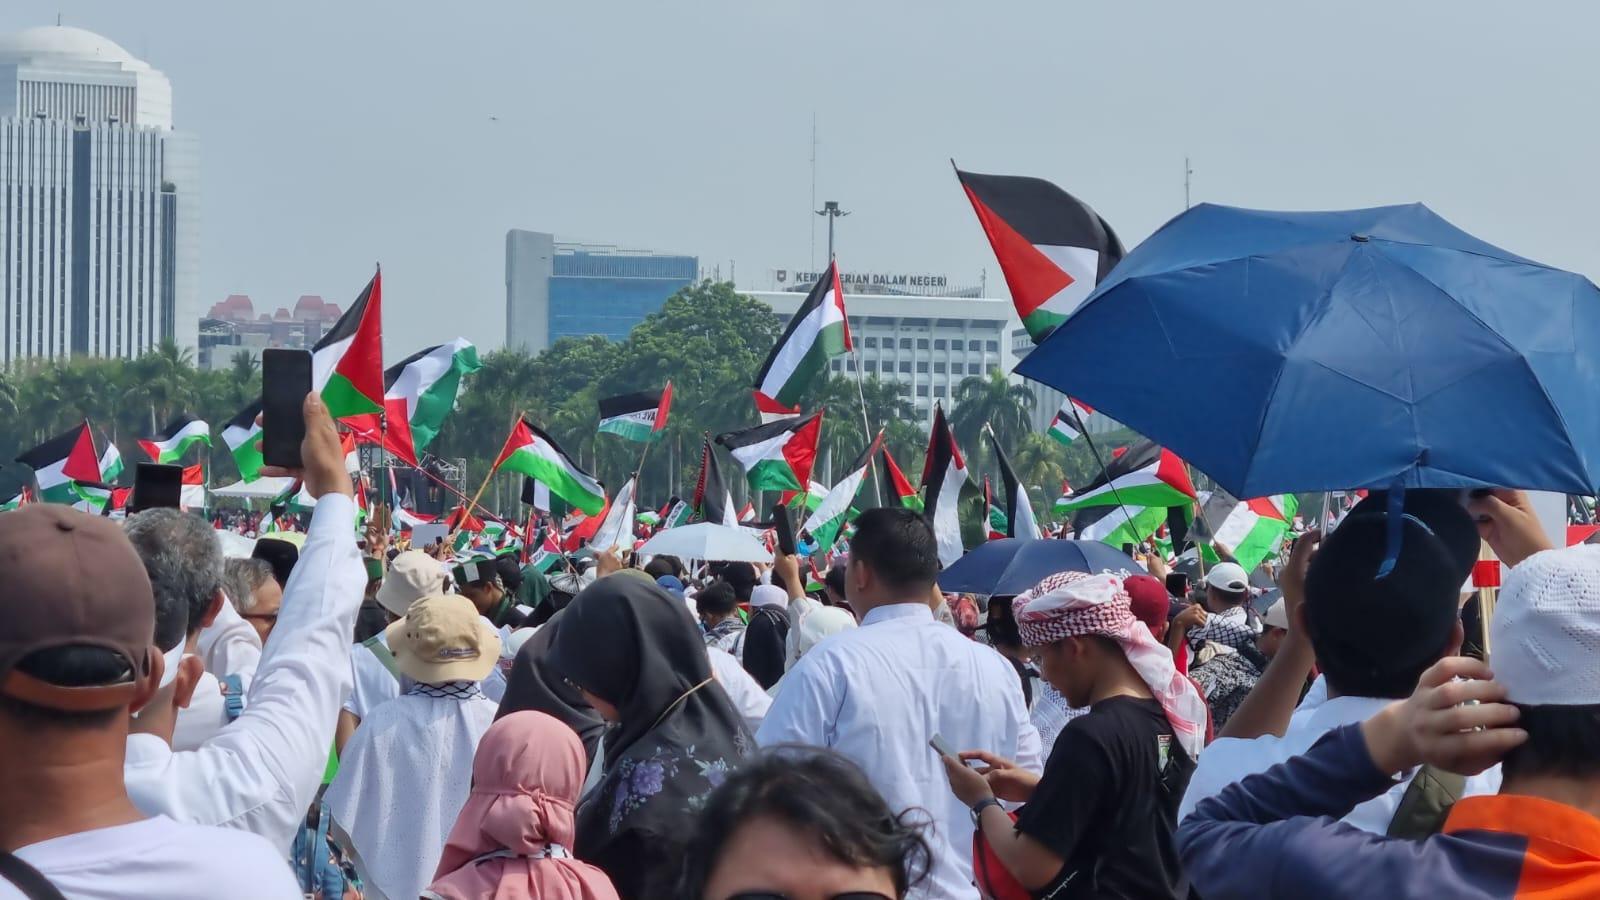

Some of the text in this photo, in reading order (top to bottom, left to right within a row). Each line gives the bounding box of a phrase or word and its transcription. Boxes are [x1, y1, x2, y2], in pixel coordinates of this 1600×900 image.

[796, 272, 947, 286] KEMERIAN DALAM NEGERI
